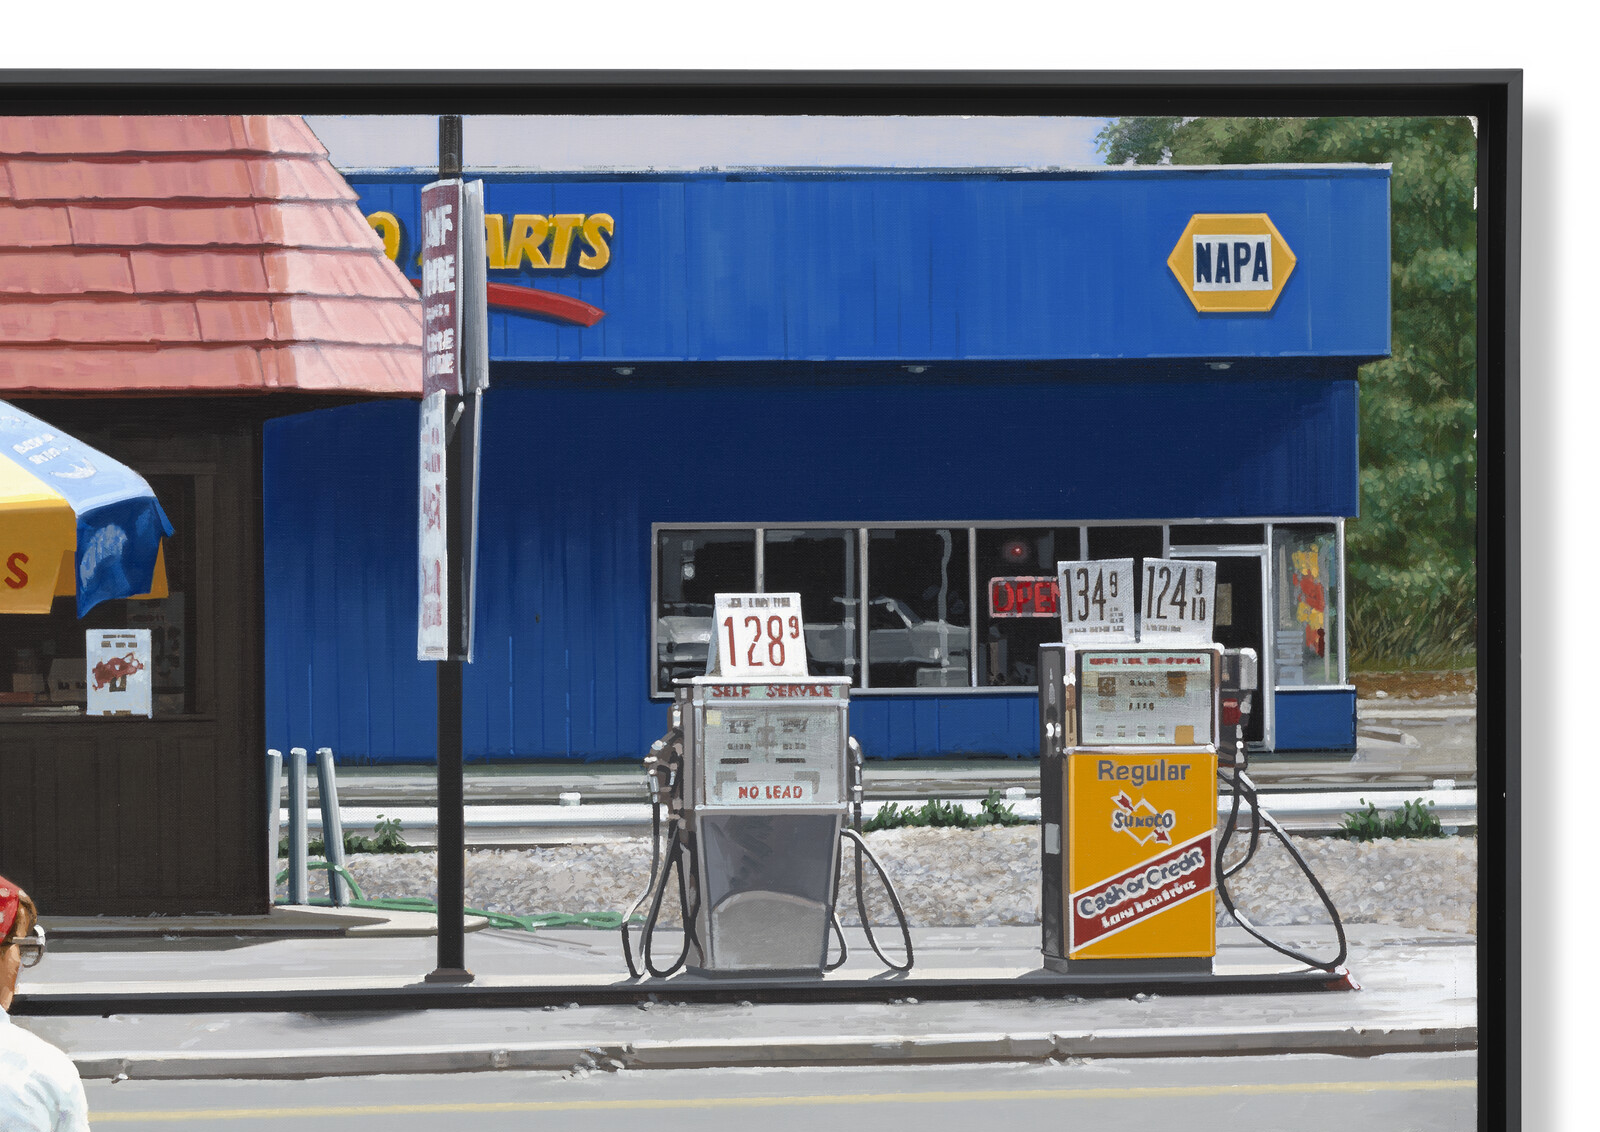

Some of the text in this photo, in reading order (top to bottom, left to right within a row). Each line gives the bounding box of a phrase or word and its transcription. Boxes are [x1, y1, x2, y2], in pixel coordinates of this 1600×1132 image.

[1196, 242, 1269, 283] NAPA
[712, 683, 833, 698] SELF SERVICE
[1098, 759, 1191, 787] Regular
[738, 785, 803, 799] NO LEAD
[1113, 811, 1174, 829] SUNOCO
[1080, 884, 1127, 916] Cash
[1127, 876, 1145, 896] or
[1146, 850, 1204, 887] Credit
